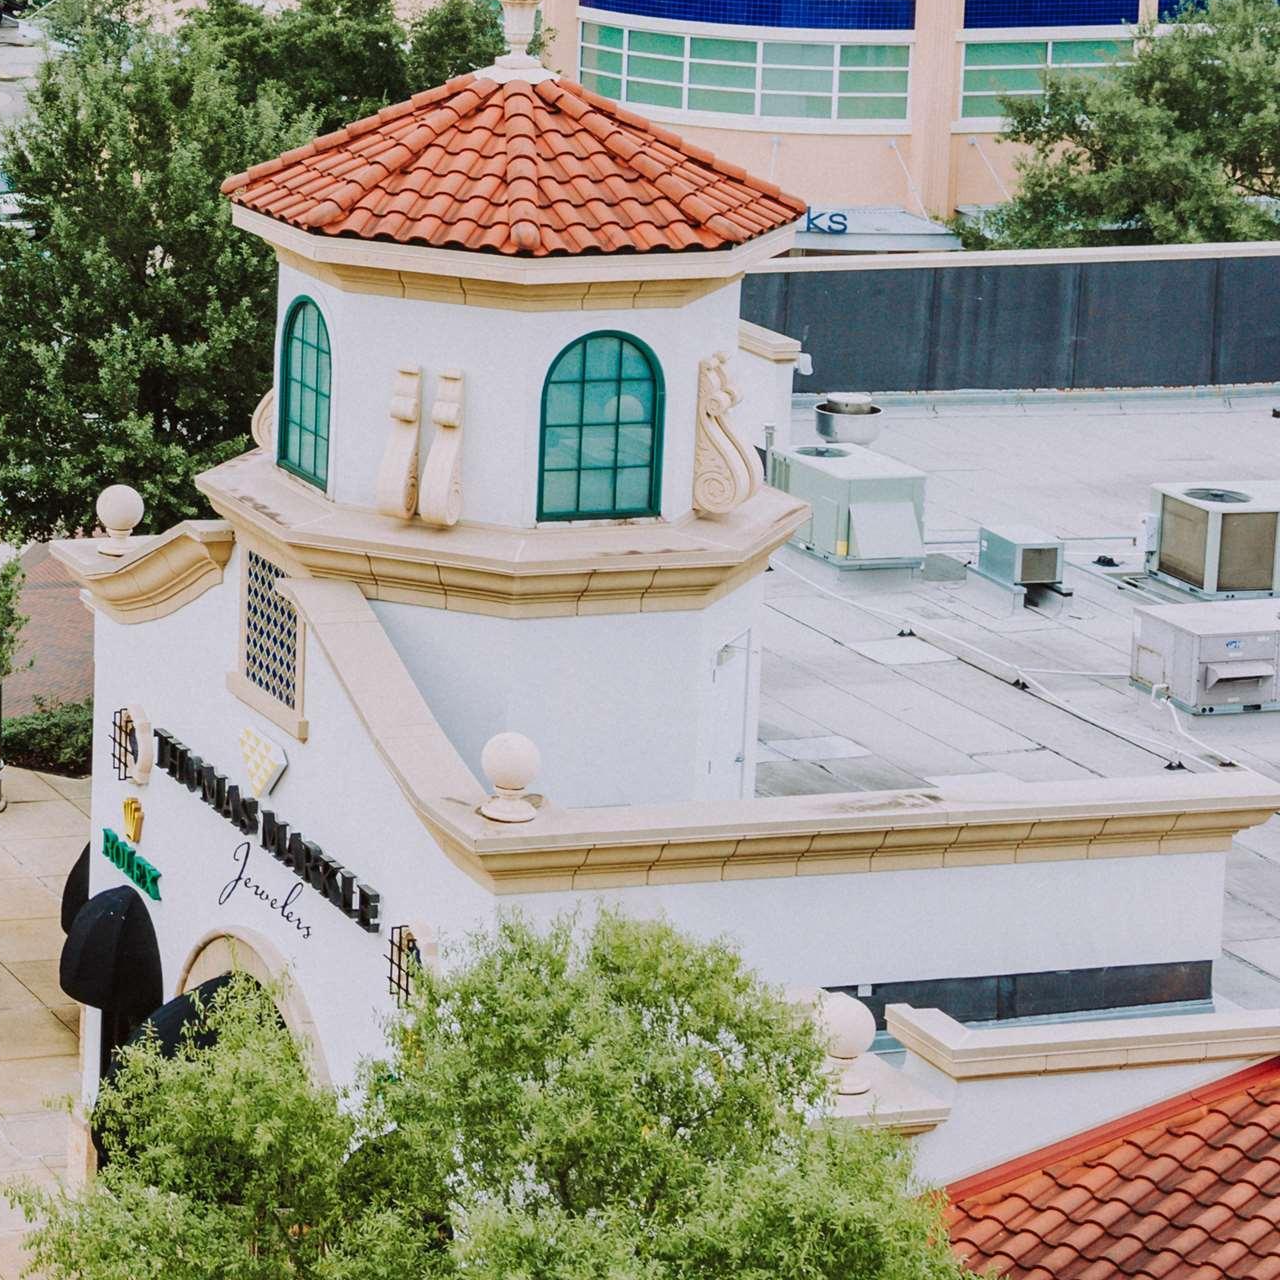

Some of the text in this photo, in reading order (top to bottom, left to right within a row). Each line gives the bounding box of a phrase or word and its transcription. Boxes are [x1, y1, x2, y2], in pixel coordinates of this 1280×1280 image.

[806, 206, 848, 234] ks
[102, 828, 162, 901] ROLEX
[153, 728, 381, 934] THOMAS MARKLE
[218, 841, 313, 940] Jewelers
